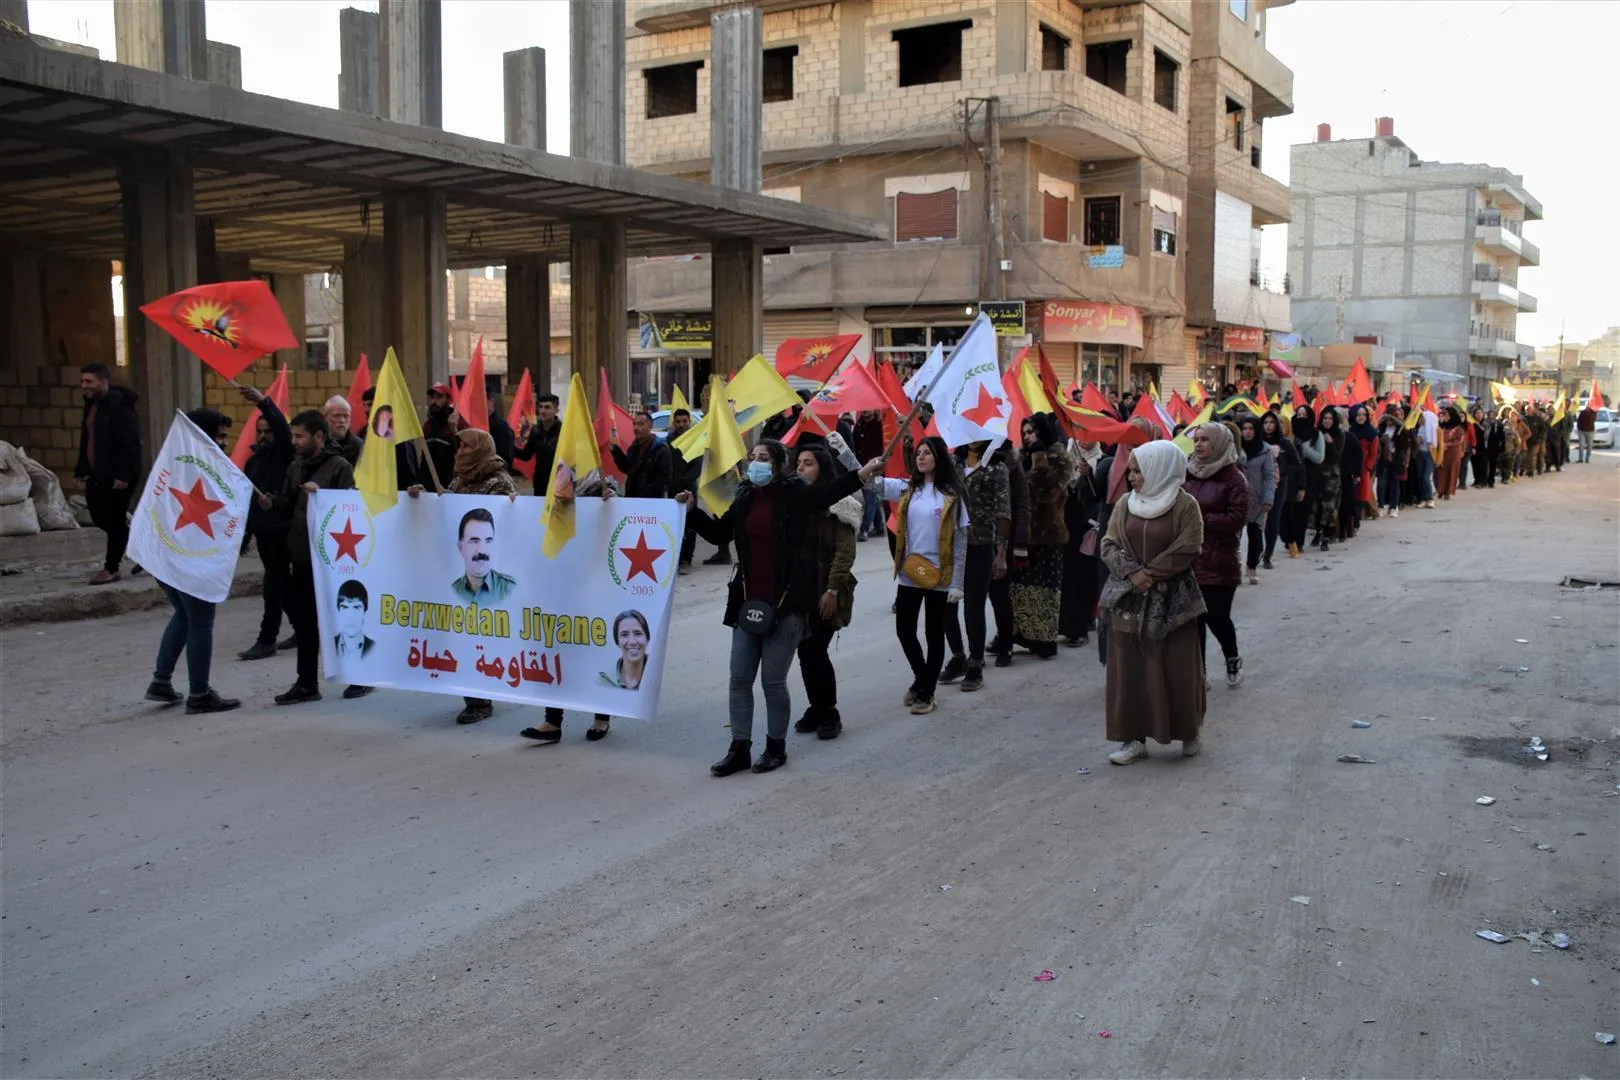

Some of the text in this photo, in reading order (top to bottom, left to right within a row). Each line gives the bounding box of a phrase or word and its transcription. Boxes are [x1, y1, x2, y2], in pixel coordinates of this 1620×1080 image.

[1044, 303, 1095, 320] Sonyar
[631, 585, 655, 597] 2003
[380, 594, 607, 648] Berxwedan Jiyane
[407, 638, 562, 688] المقاومة حياة
